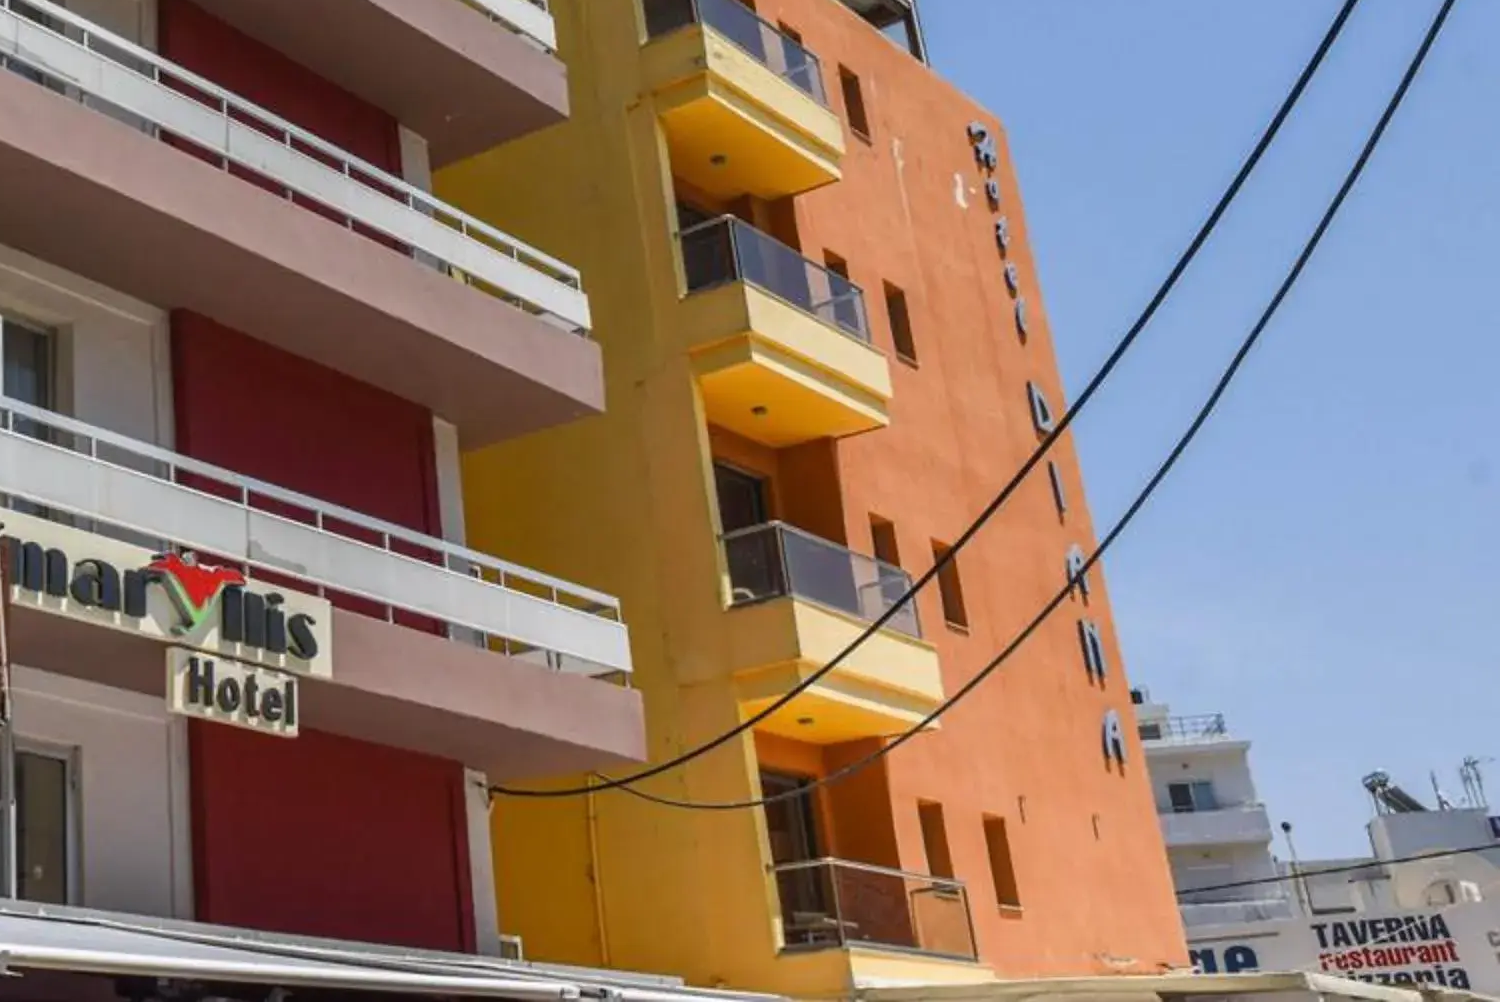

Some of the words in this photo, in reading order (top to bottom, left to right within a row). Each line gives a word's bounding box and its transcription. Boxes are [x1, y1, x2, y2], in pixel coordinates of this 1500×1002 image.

[188, 657, 295, 725] Hotel
[1310, 914, 1453, 948] TAVERNA
[1318, 940, 1460, 972] restaurant
